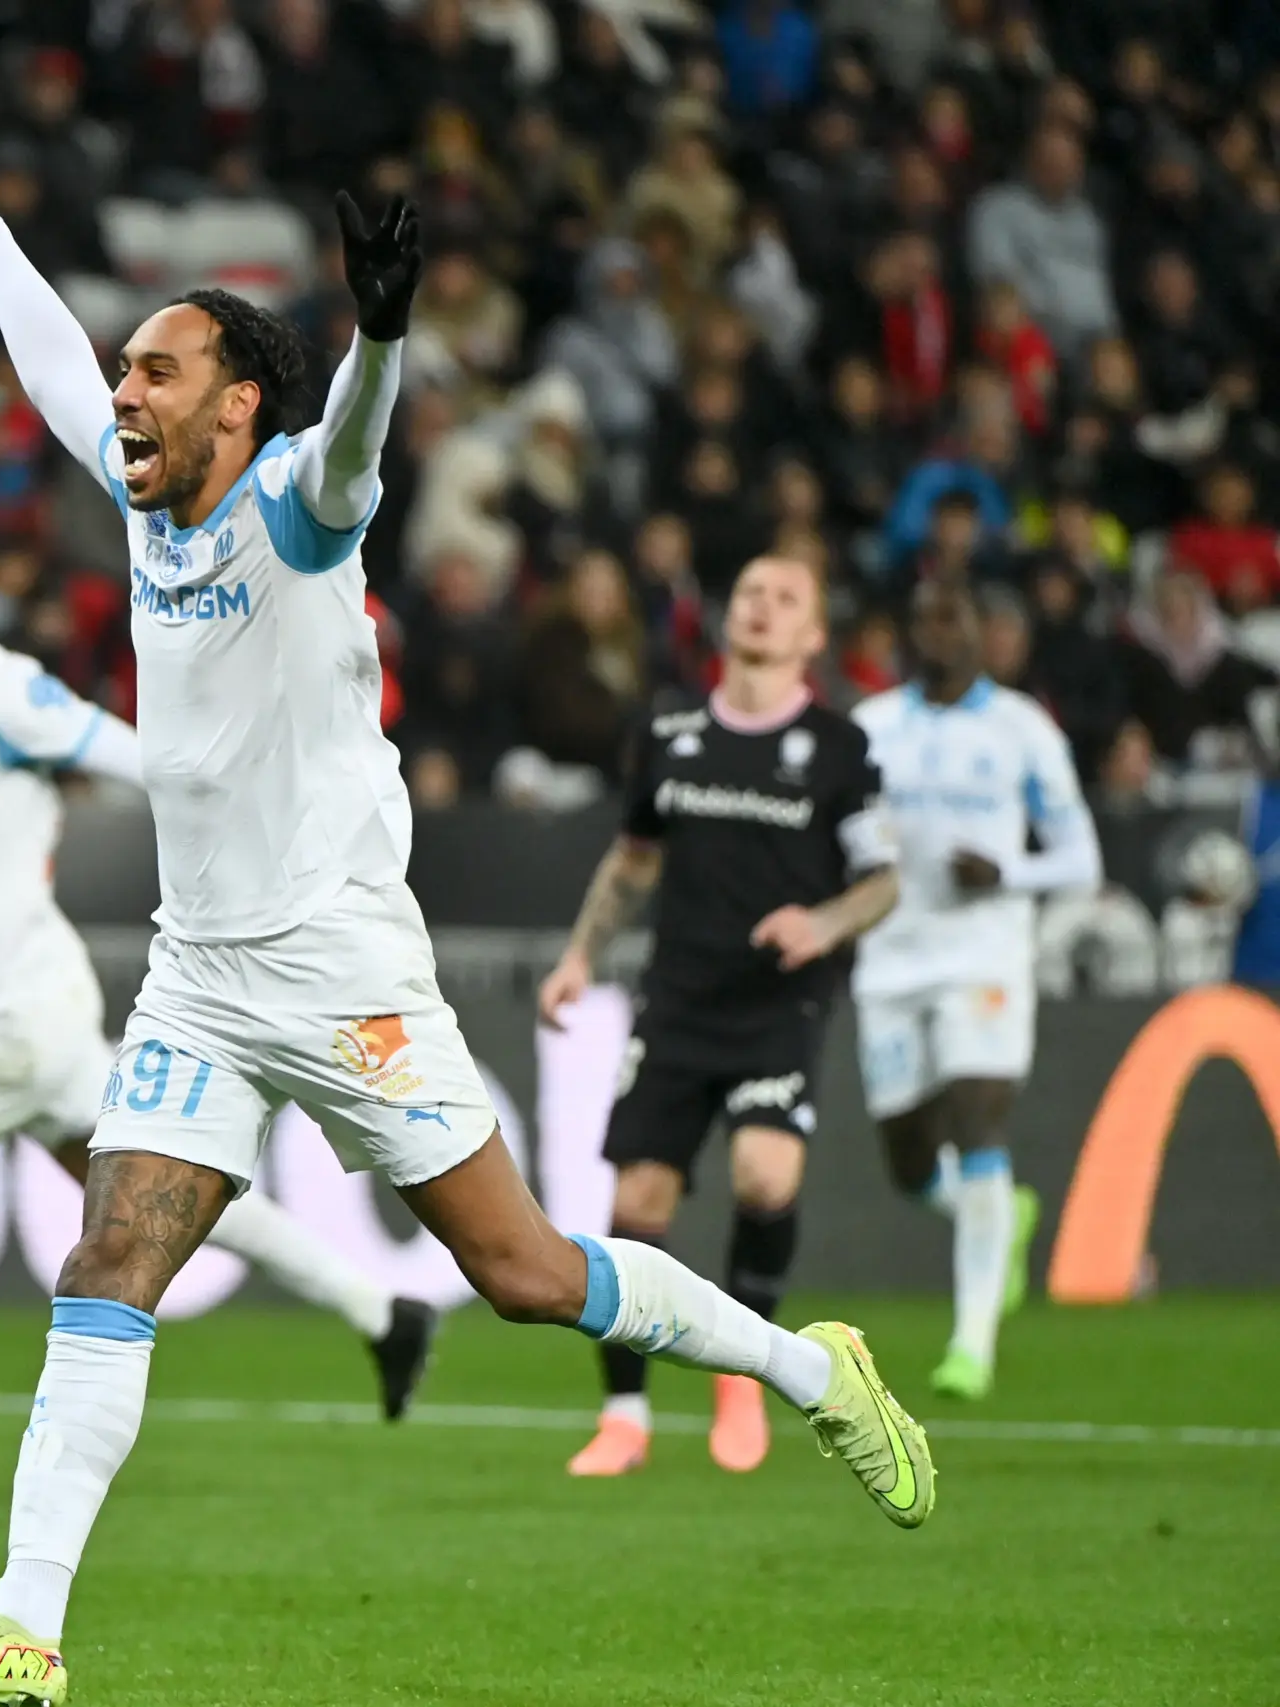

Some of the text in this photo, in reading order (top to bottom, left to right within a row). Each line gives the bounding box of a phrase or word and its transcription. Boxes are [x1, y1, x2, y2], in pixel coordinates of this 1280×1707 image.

[177, 581, 250, 620] CGM
[126, 1039, 213, 1118] 97
[364, 1055, 412, 1088] SUBLIME
